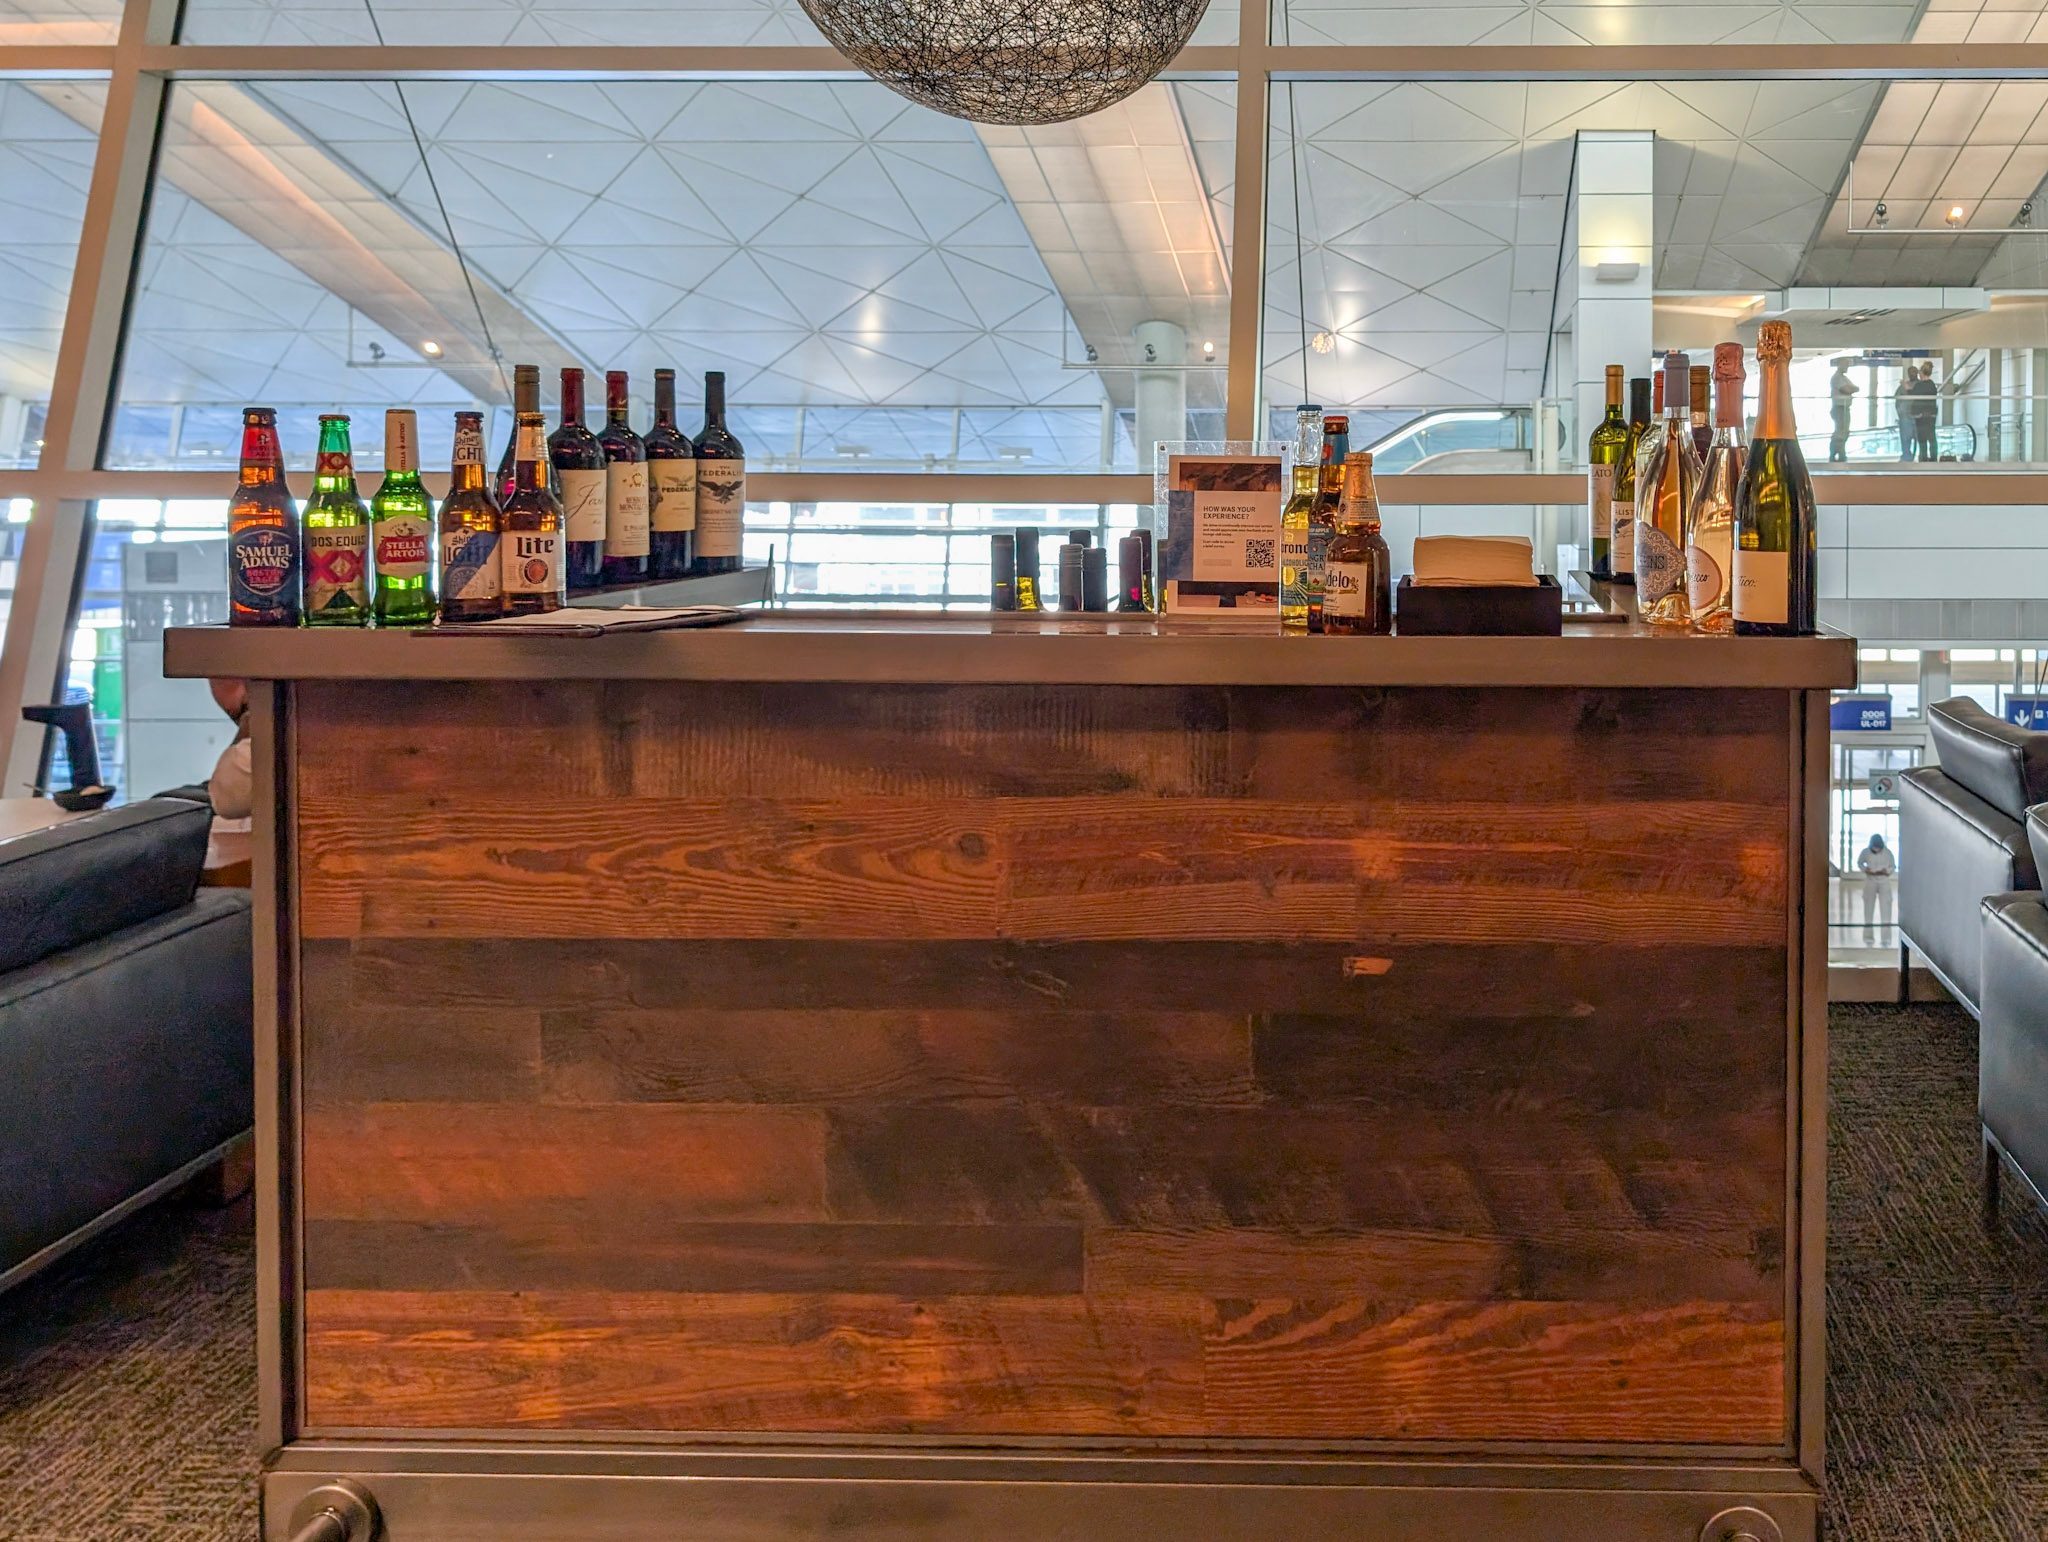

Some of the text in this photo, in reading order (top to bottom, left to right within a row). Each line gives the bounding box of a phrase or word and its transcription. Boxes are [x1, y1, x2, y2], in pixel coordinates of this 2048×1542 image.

[312, 535, 366, 547] DOS EQUIS
[386, 541, 425, 550] STELLA
[236, 544, 293, 558] SAMUEL
[386, 549, 425, 558] ARTOIS
[516, 536, 554, 559] Lite
[240, 557, 290, 570] ADAMS
[1862, 710, 1886, 718] DOOR
